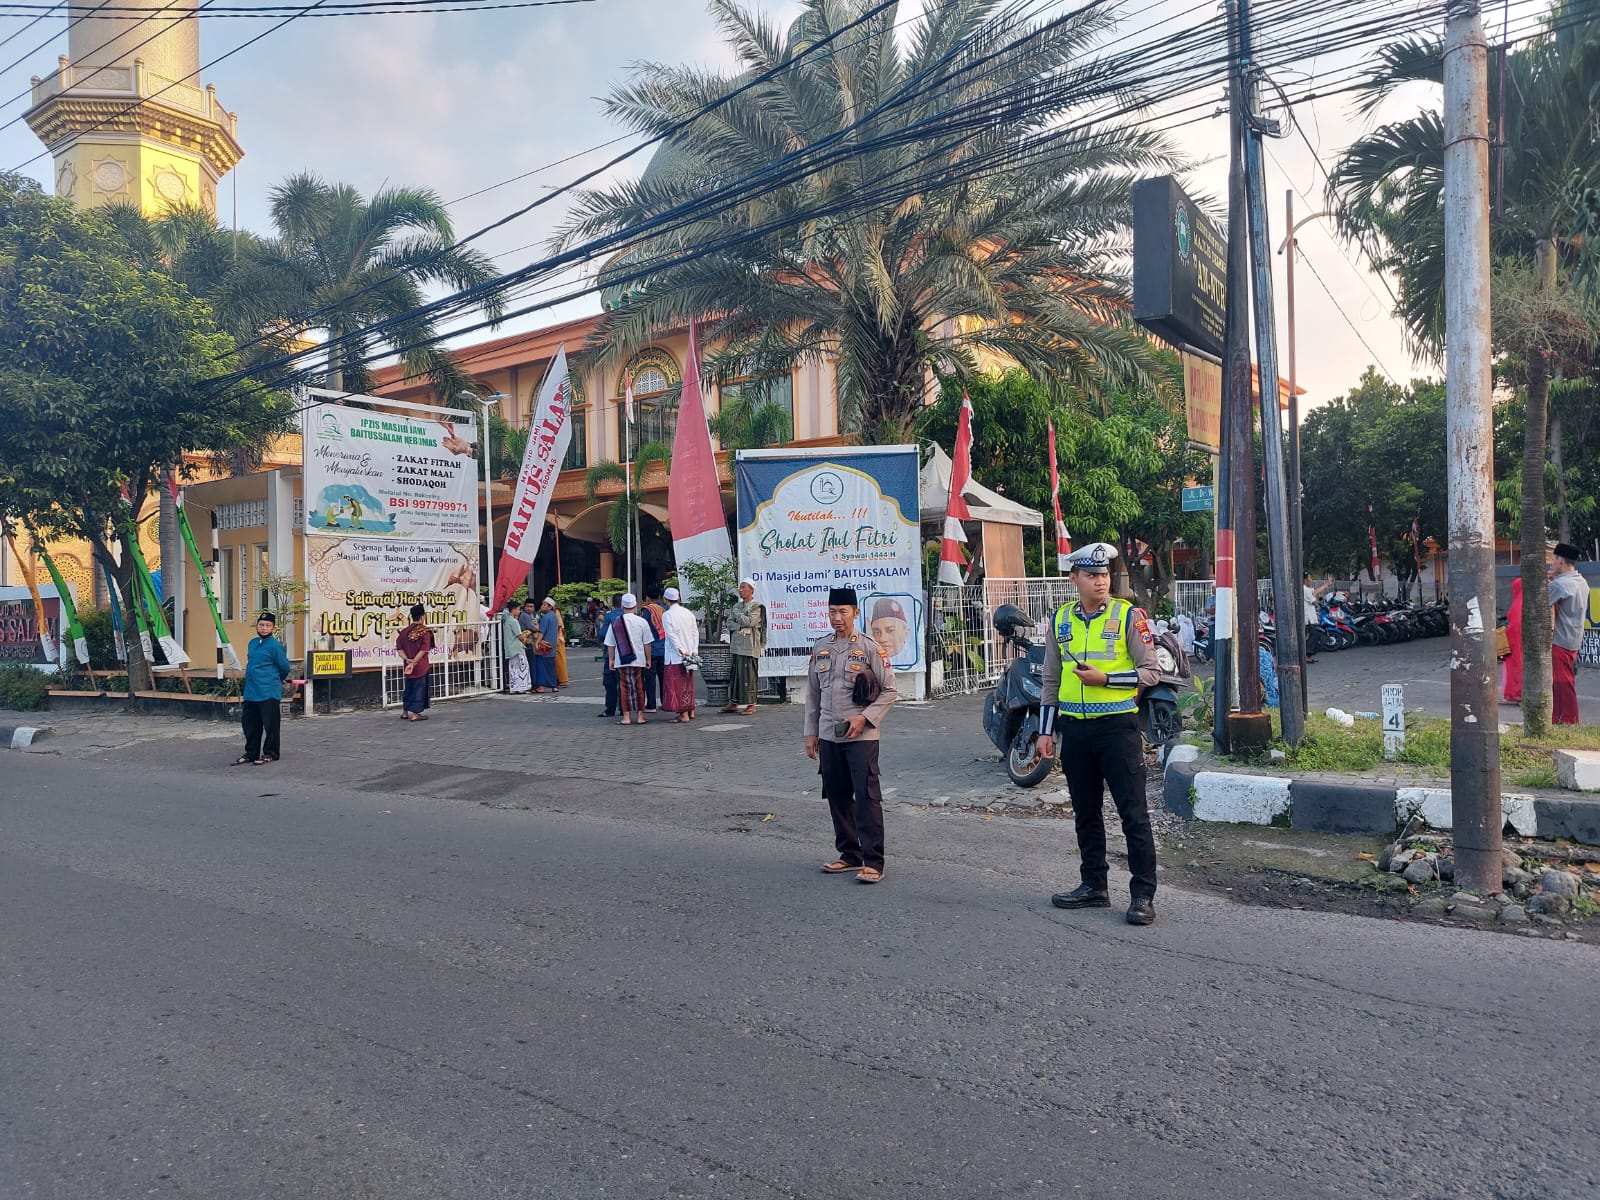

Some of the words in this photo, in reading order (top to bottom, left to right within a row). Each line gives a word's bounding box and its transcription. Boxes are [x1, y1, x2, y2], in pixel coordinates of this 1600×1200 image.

[382, 422, 408, 434] MASJID
[351, 428, 403, 443] BAITUSSALAM
[314, 445, 360, 460] Menerima
[397, 455, 428, 465] ZAKAT
[431, 459, 461, 469] FITRAH
[325, 461, 383, 477] Menyalurkan
[397, 466, 428, 476] ZAKAT
[431, 469, 455, 478] MAAL
[397, 477, 447, 489] SHODAQOH
[390, 498, 408, 507] BSI
[413, 499, 468, 512] 997799971
[507, 464, 543, 552] BAITUS
[760, 529, 817, 556] Sholat
[818, 527, 852, 555] Idul
[856, 525, 897, 552] Fitri
[353, 543, 382, 552] Segenap
[336, 552, 360, 561] Masjid
[408, 556, 427, 564] Salam
[841, 553, 867, 561] Syawal
[388, 565, 411, 574] Gresik
[752, 572, 763, 581] Di
[766, 571, 801, 583] Masjid
[834, 567, 910, 579] BAITUSSALAM
[843, 580, 877, 591] Gresik
[346, 590, 398, 611] Selamat
[397, 590, 424, 605] Hari
[424, 591, 456, 610] Raya
[770, 601, 788, 609] Hari
[770, 611, 801, 620] Tanggal
[819, 611, 829, 620] Ap
[321, 611, 361, 643] Idul
[771, 622, 793, 630] Pukul
[1388, 713, 1400, 728] 4
